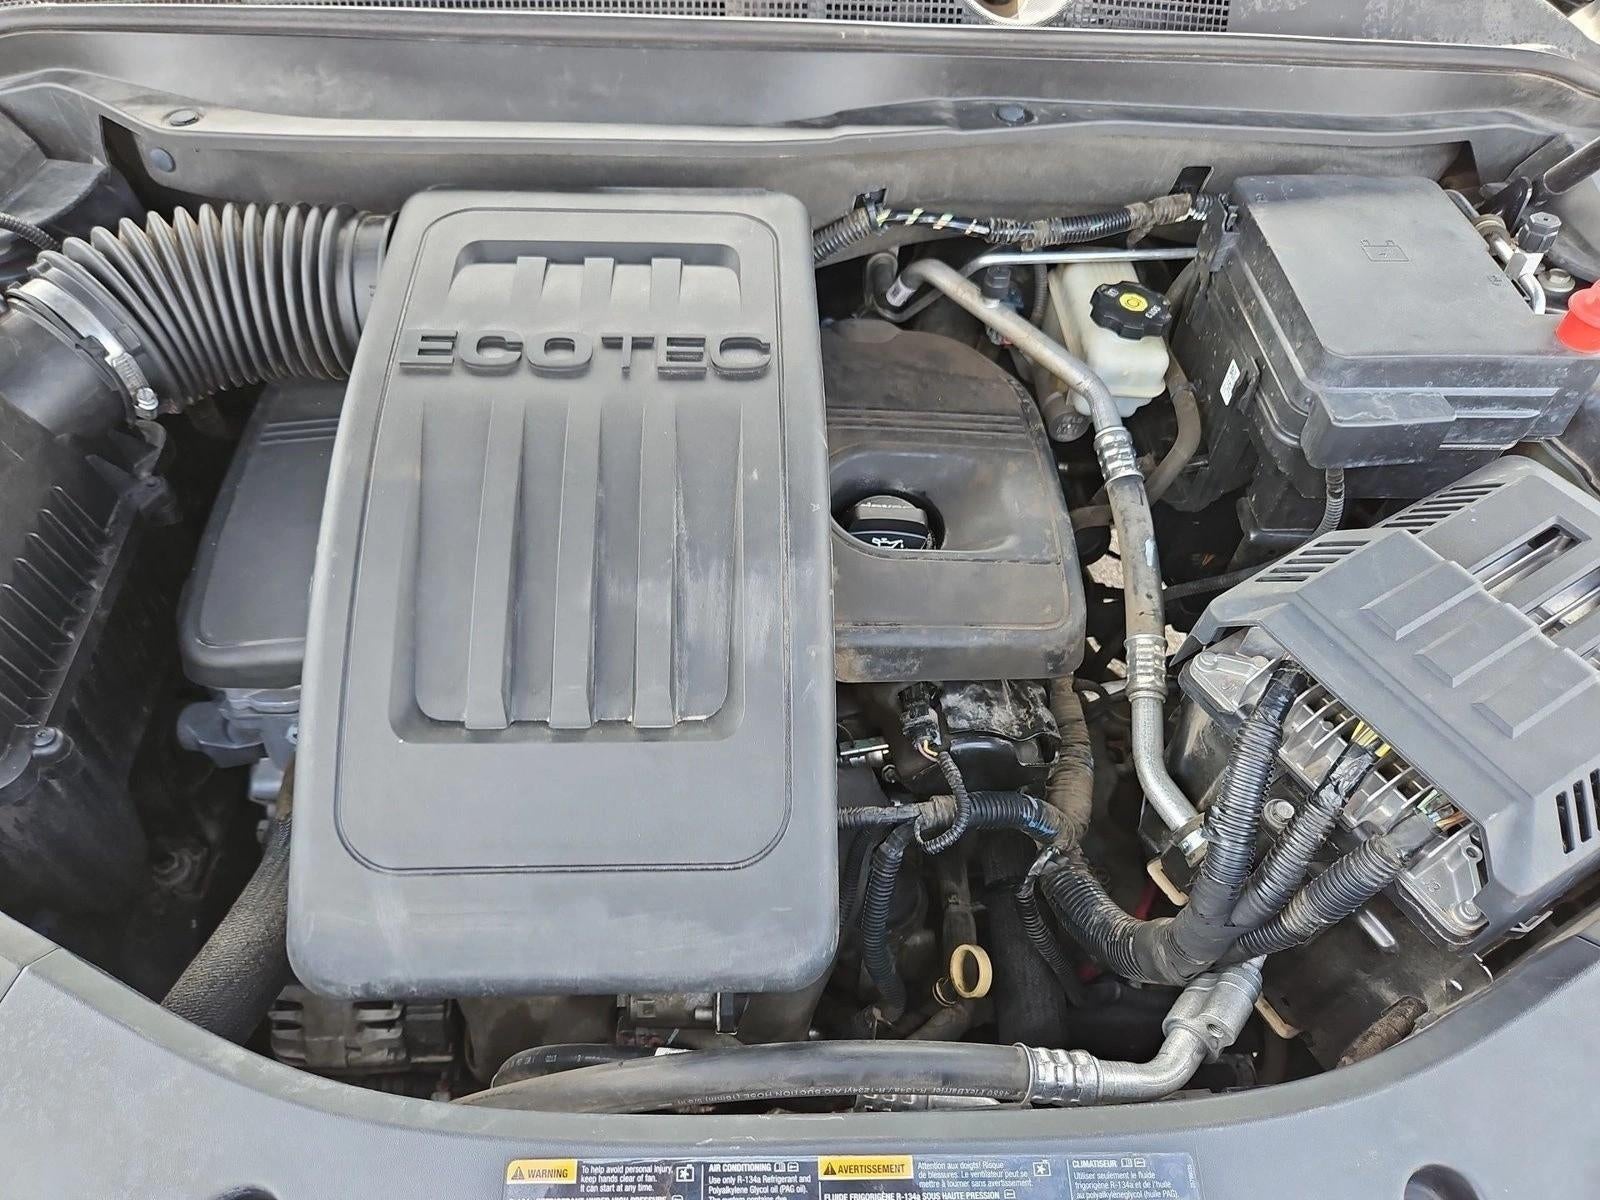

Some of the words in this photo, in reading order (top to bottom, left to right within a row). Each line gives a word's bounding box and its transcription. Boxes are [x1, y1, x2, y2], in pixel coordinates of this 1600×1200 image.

[400, 329, 772, 377] ECOTEC
[708, 1163, 721, 1173] AIR
[722, 1162, 772, 1173] CONDITIONING
[837, 1163, 905, 1175] AVERTISSEMENT
[917, 1161, 946, 1170] Attention
[947, 1162, 959, 1170] aux
[982, 1161, 1004, 1171] Risque
[1072, 1159, 1118, 1169] CLIMATISEUR
[527, 1168, 569, 1179] WARNING
[581, 1165, 590, 1174] To
[590, 1165, 605, 1175] help
[605, 1165, 624, 1174] avoid
[624, 1165, 653, 1175] personal
[918, 1171, 927, 1179] de
[961, 1170, 970, 1179] Le
[970, 1170, 1004, 1179] ventilateur
[1004, 1170, 1019, 1179] peut
[1073, 1171, 1096, 1180] Utiliser
[1096, 1171, 1130, 1180] seulement
[1130, 1171, 1138, 1180] le
[1138, 1170, 1157, 1180] fluide
[580, 1174, 597, 1184] keep
[598, 1174, 619, 1183] hands
[619, 1174, 636, 1183] clear
[636, 1174, 645, 1183] of
[644, 1174, 658, 1183] fan.
[708, 1175, 721, 1185] Use
[722, 1175, 736, 1186] only
[736, 1175, 761, 1184] R-134a
[762, 1174, 798, 1185] Refrigerant
[798, 1174, 812, 1184] and
[919, 1180, 940, 1188] mettre
[946, 1180, 971, 1188] tourner
[586, 1185, 599, 1193] can
[599, 1184, 616, 1193] start
[616, 1184, 624, 1193] at
[624, 1184, 637, 1194] any
[637, 1183, 655, 1192] time.
[1110, 1180, 1135, 1189] R-134a
[1135, 1180, 1142, 1189] et
[1142, 1180, 1152, 1188] de
[749, 1185, 769, 1195] Glycol
[770, 1185, 779, 1194] oil
[779, 1185, 795, 1195] (PAG
[1076, 1191, 1085, 1199] au
[895, 1192, 921, 1200] R-134a
[921, 1191, 942, 1200] SOUS
[941, 1191, 966, 1200] HAUTE
[966, 1191, 1001, 1200] PRESSION
